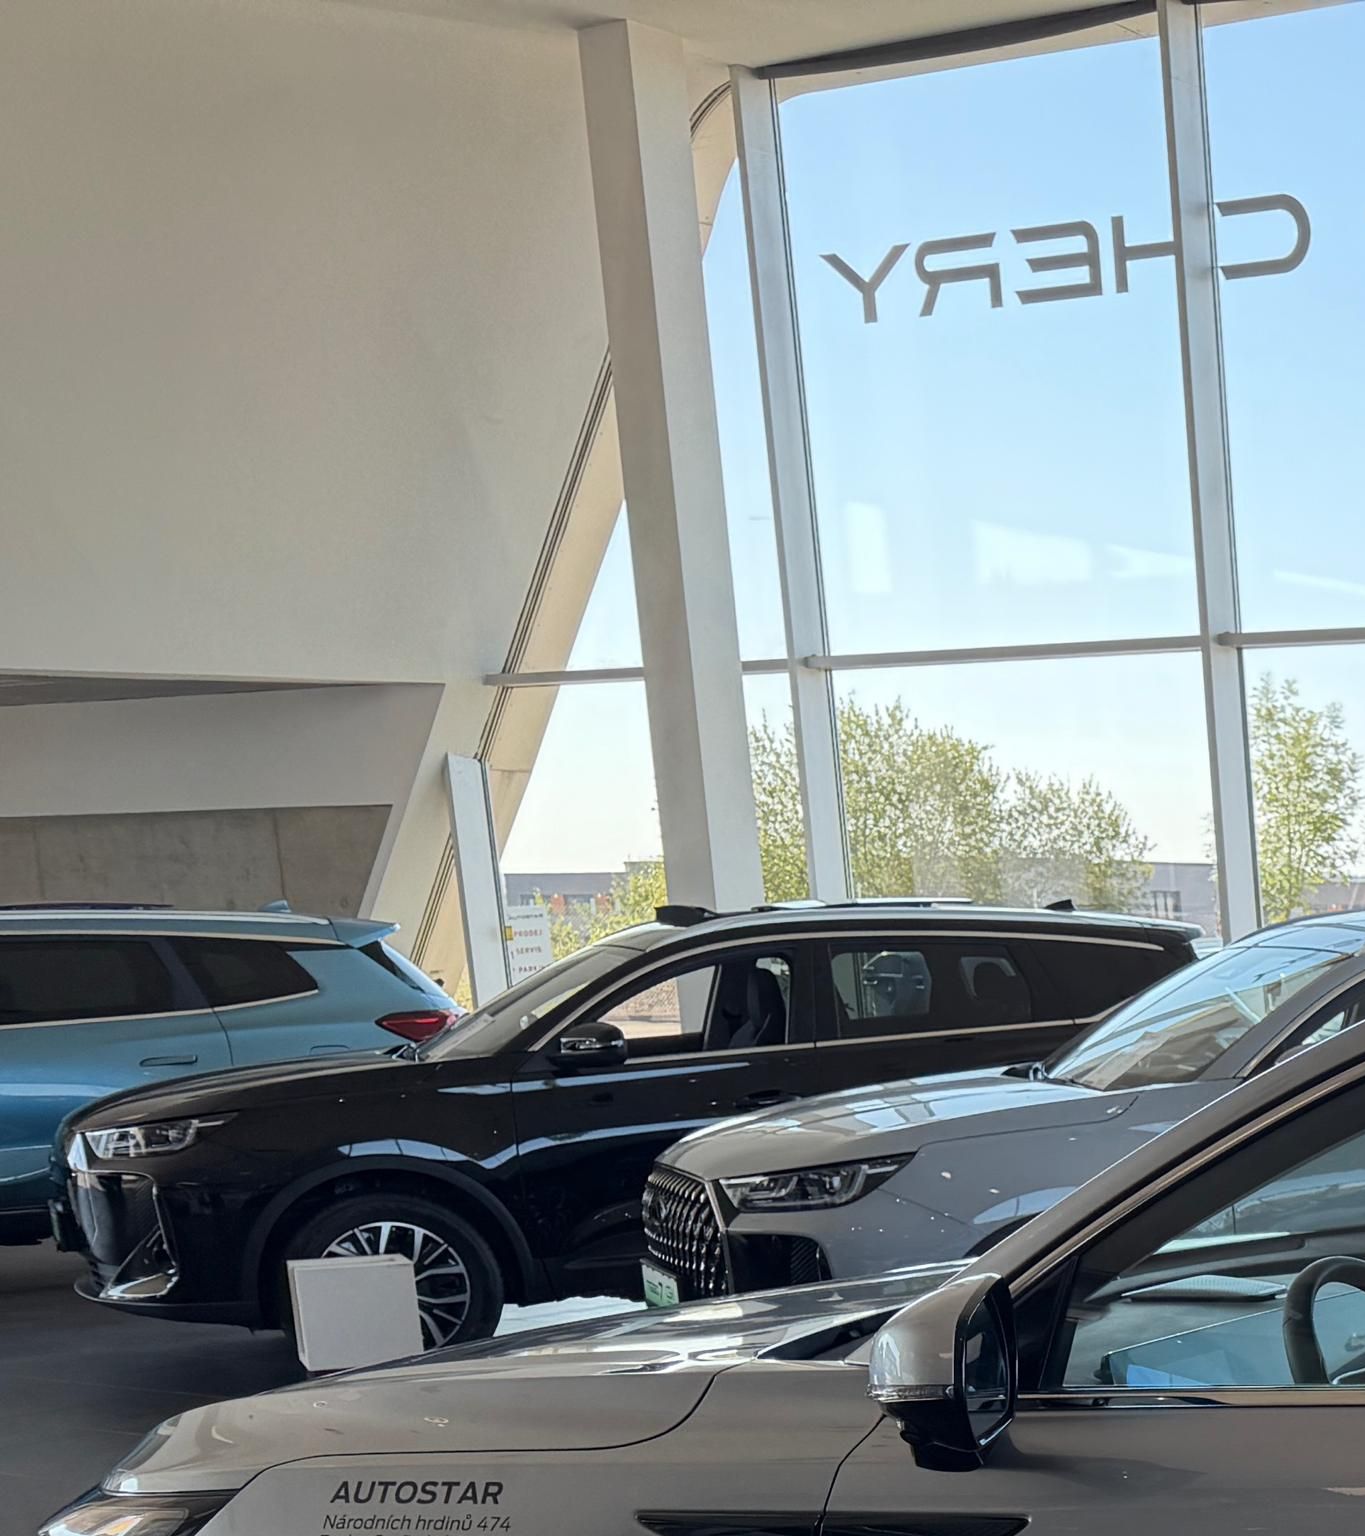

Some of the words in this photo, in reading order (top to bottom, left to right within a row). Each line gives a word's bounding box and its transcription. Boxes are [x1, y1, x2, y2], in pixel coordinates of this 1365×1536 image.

[330, 1481, 503, 1505] AUTOSTAR
[323, 1514, 411, 1532] Národních
[415, 1514, 472, 1532] hrdinů
[476, 1516, 512, 1532] 474
